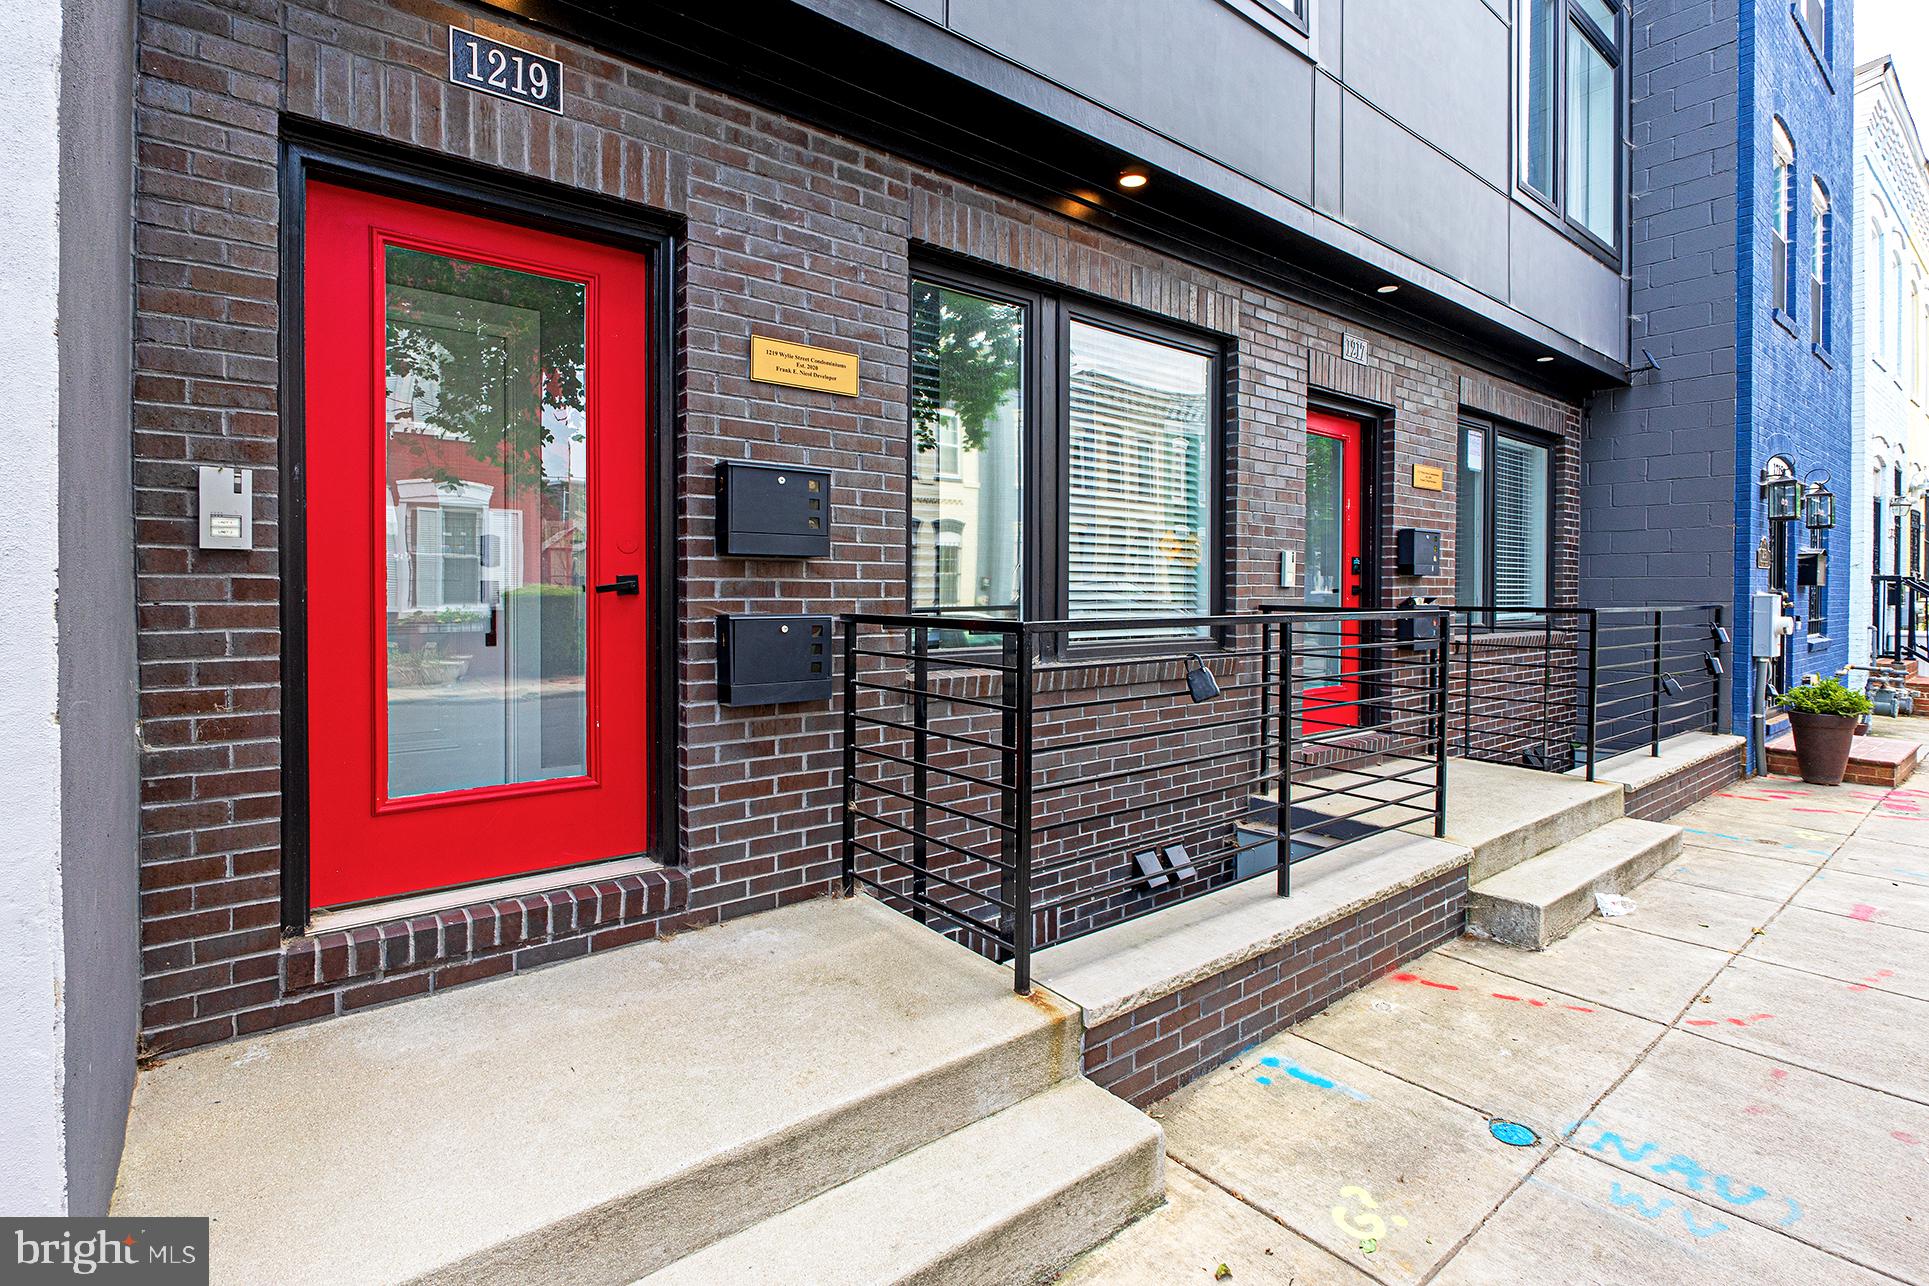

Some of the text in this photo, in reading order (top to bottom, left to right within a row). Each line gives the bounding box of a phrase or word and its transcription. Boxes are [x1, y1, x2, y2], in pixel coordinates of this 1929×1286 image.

[466, 42, 548, 100] 1219
[766, 349, 847, 369] 1219 Wylie Street Condominiums
[1345, 338, 1365, 361] 1217
[775, 366, 792, 374] Frank
[813, 372, 837, 381] Developer
